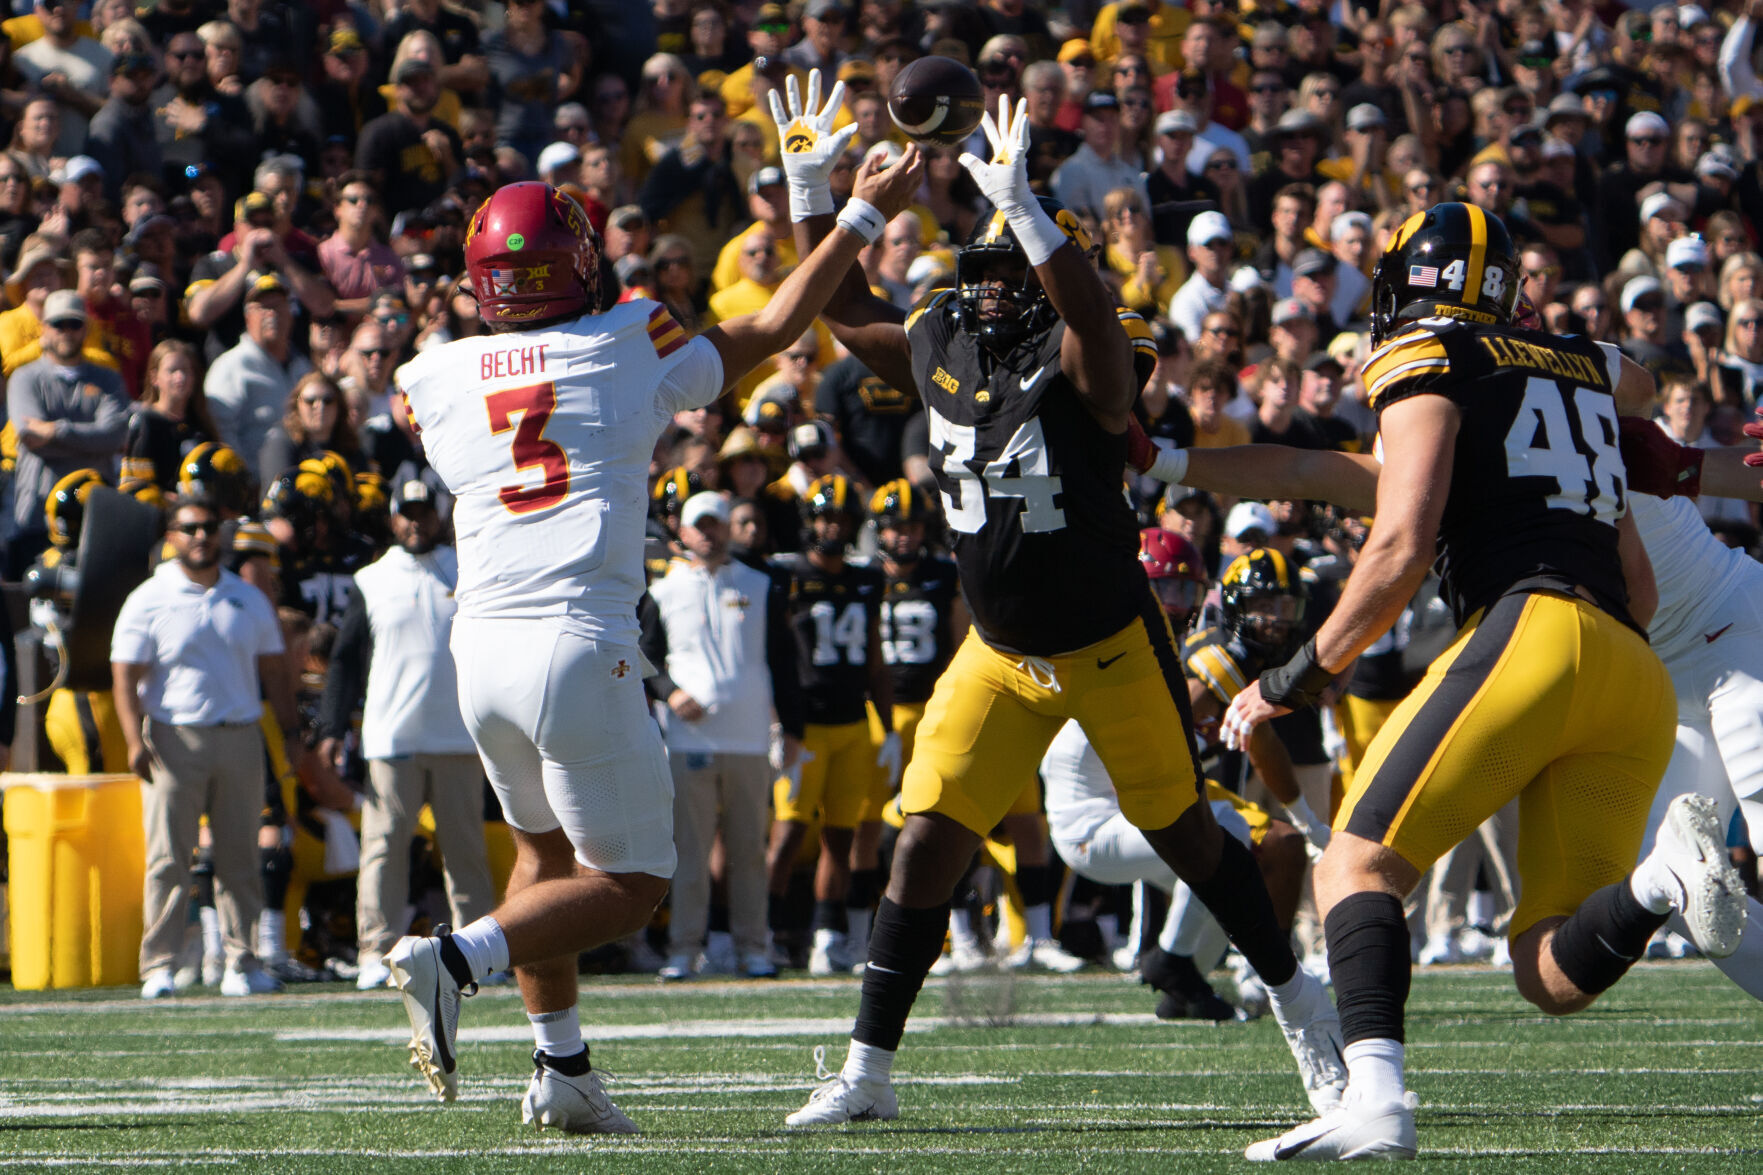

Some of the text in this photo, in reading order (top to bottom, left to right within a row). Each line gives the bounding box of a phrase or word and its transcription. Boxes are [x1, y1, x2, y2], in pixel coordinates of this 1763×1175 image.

[535, 280, 545, 291] 3
[480, 343, 550, 381] BECHT
[1480, 335, 1605, 387] LLEWELLYN
[483, 379, 572, 517] 3
[928, 405, 1068, 534] 34
[1503, 375, 1629, 528] 48
[810, 600, 868, 666] 14
